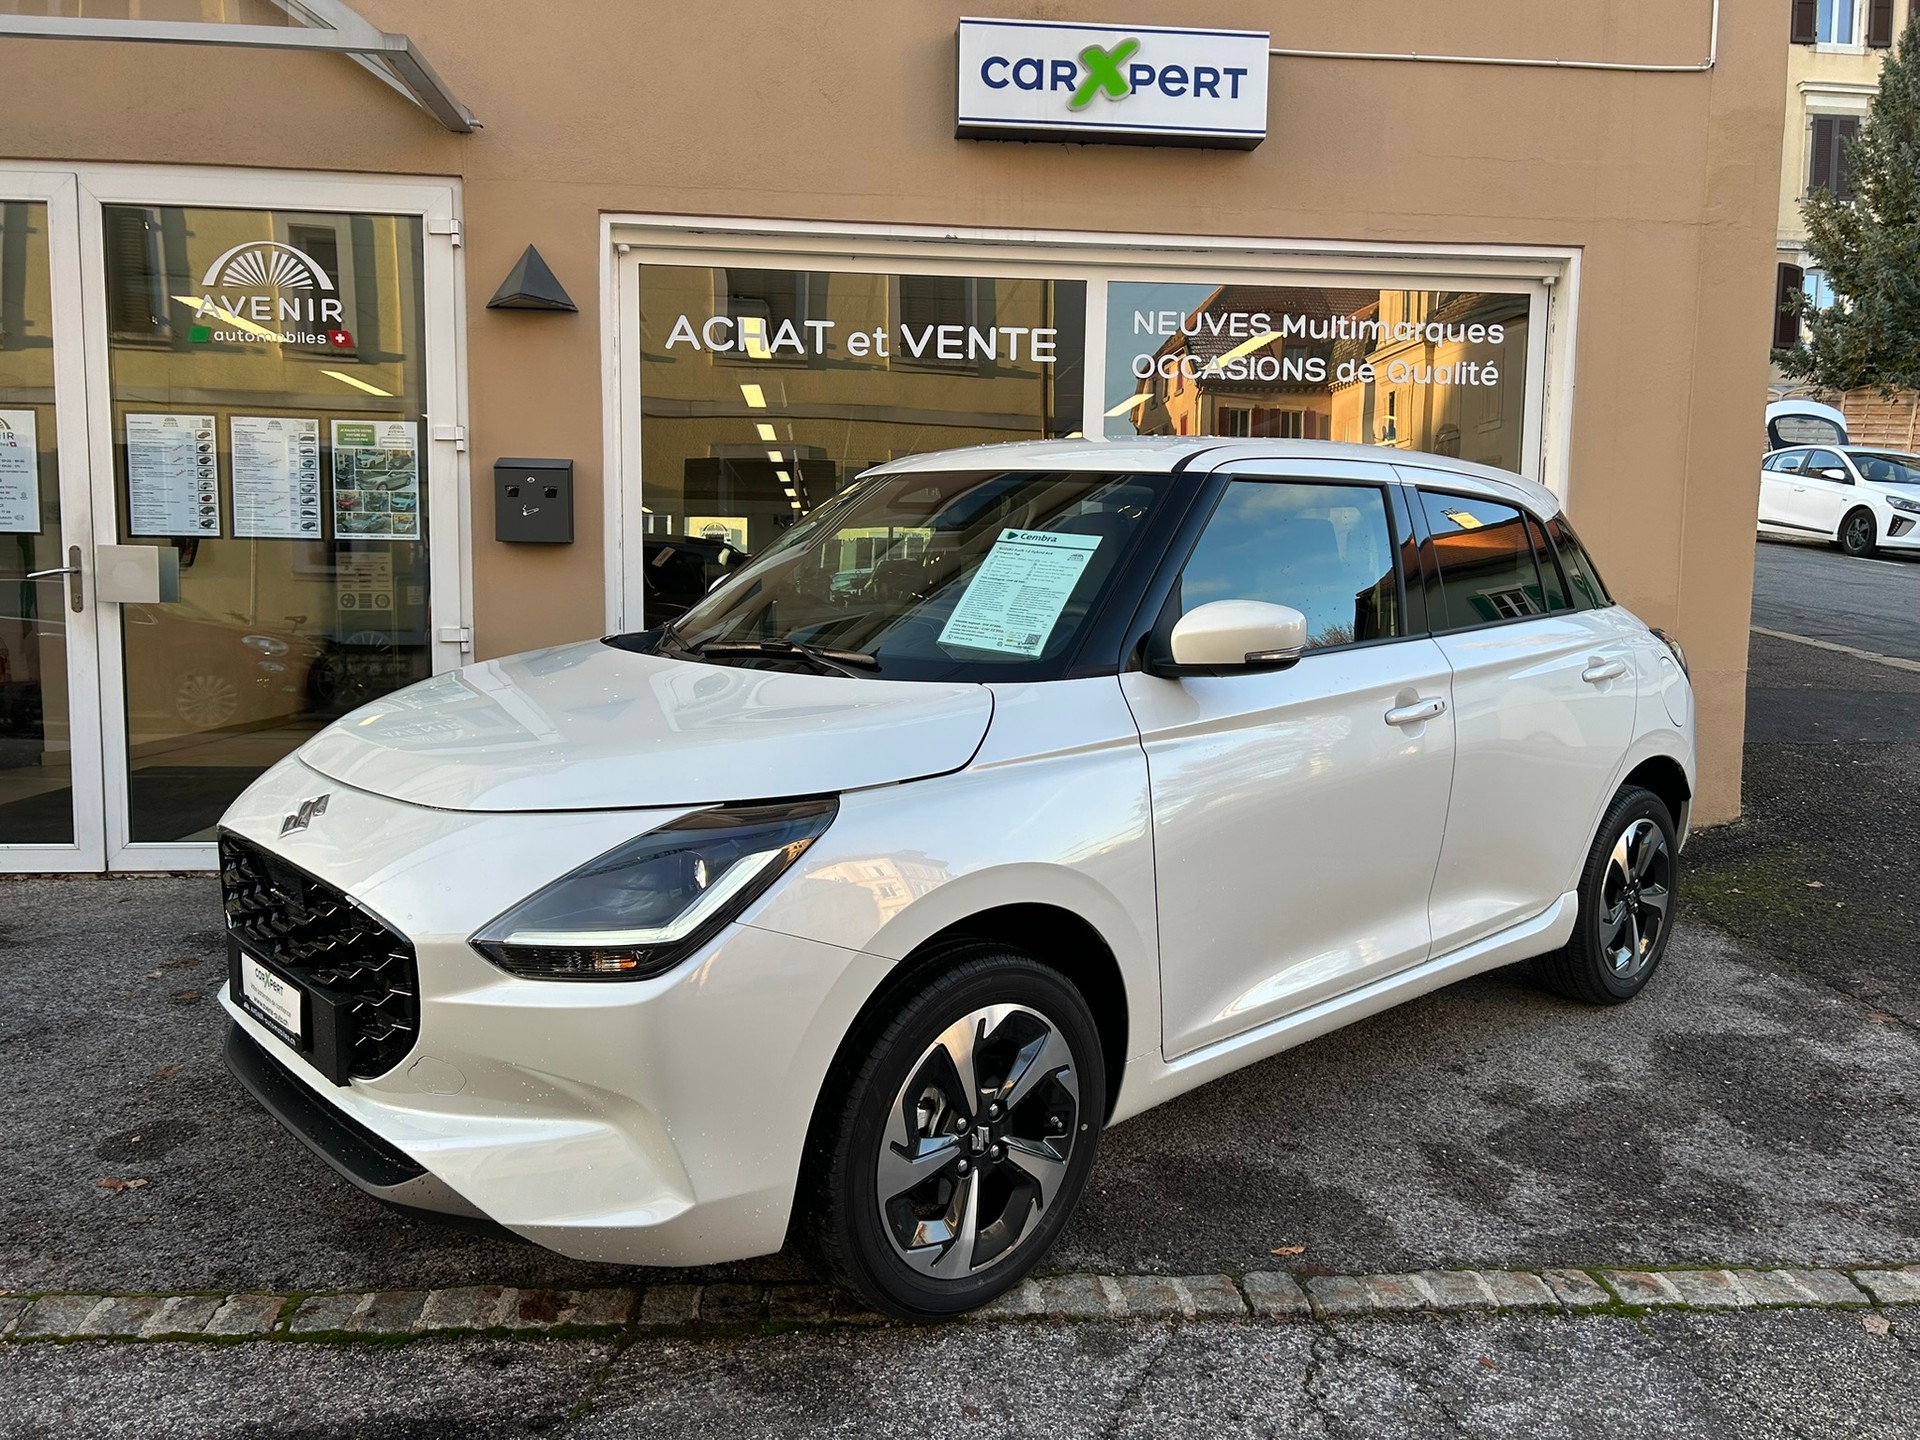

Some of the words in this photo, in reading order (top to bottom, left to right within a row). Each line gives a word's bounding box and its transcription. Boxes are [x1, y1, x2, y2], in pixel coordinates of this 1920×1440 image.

[195, 294, 344, 323] AVENIR
[213, 329, 327, 345] automobiles
[665, 314, 835, 355] ACHAT
[847, 327, 889, 358] et
[900, 323, 1057, 363] VENTE
[1133, 310, 1271, 338] NEUVES
[1282, 314, 1504, 345] Multimarques
[1131, 353, 1326, 383] OCCASIONS
[1336, 358, 1375, 384] de
[1387, 358, 1499, 387] Qualité
[1020, 532, 1058, 543] Cembra
